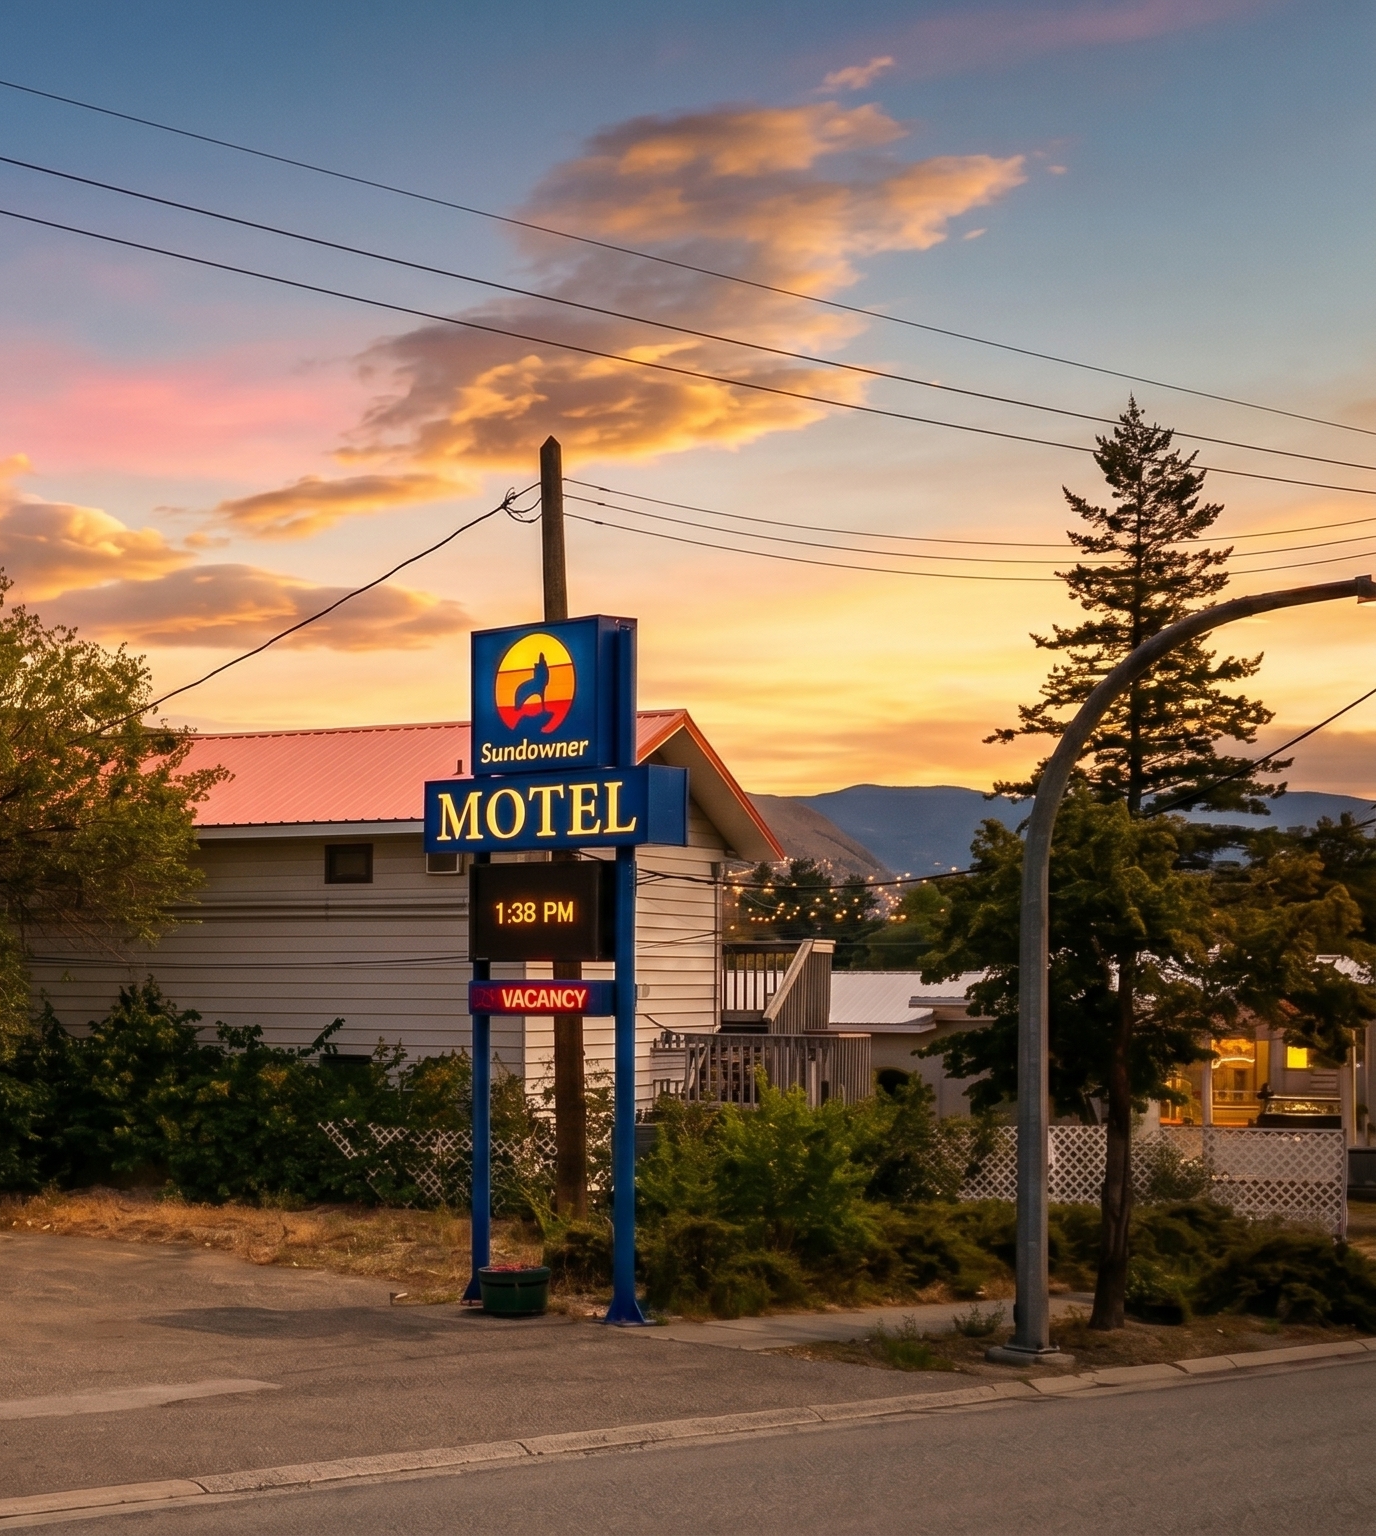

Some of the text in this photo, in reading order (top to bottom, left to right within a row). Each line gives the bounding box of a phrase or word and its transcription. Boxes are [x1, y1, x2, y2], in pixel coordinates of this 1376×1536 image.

[481, 738, 589, 764] Sundowner
[436, 781, 637, 841] MOTEL
[495, 901, 574, 925] 1:38 PM
[501, 989, 587, 1008] VACANCY
